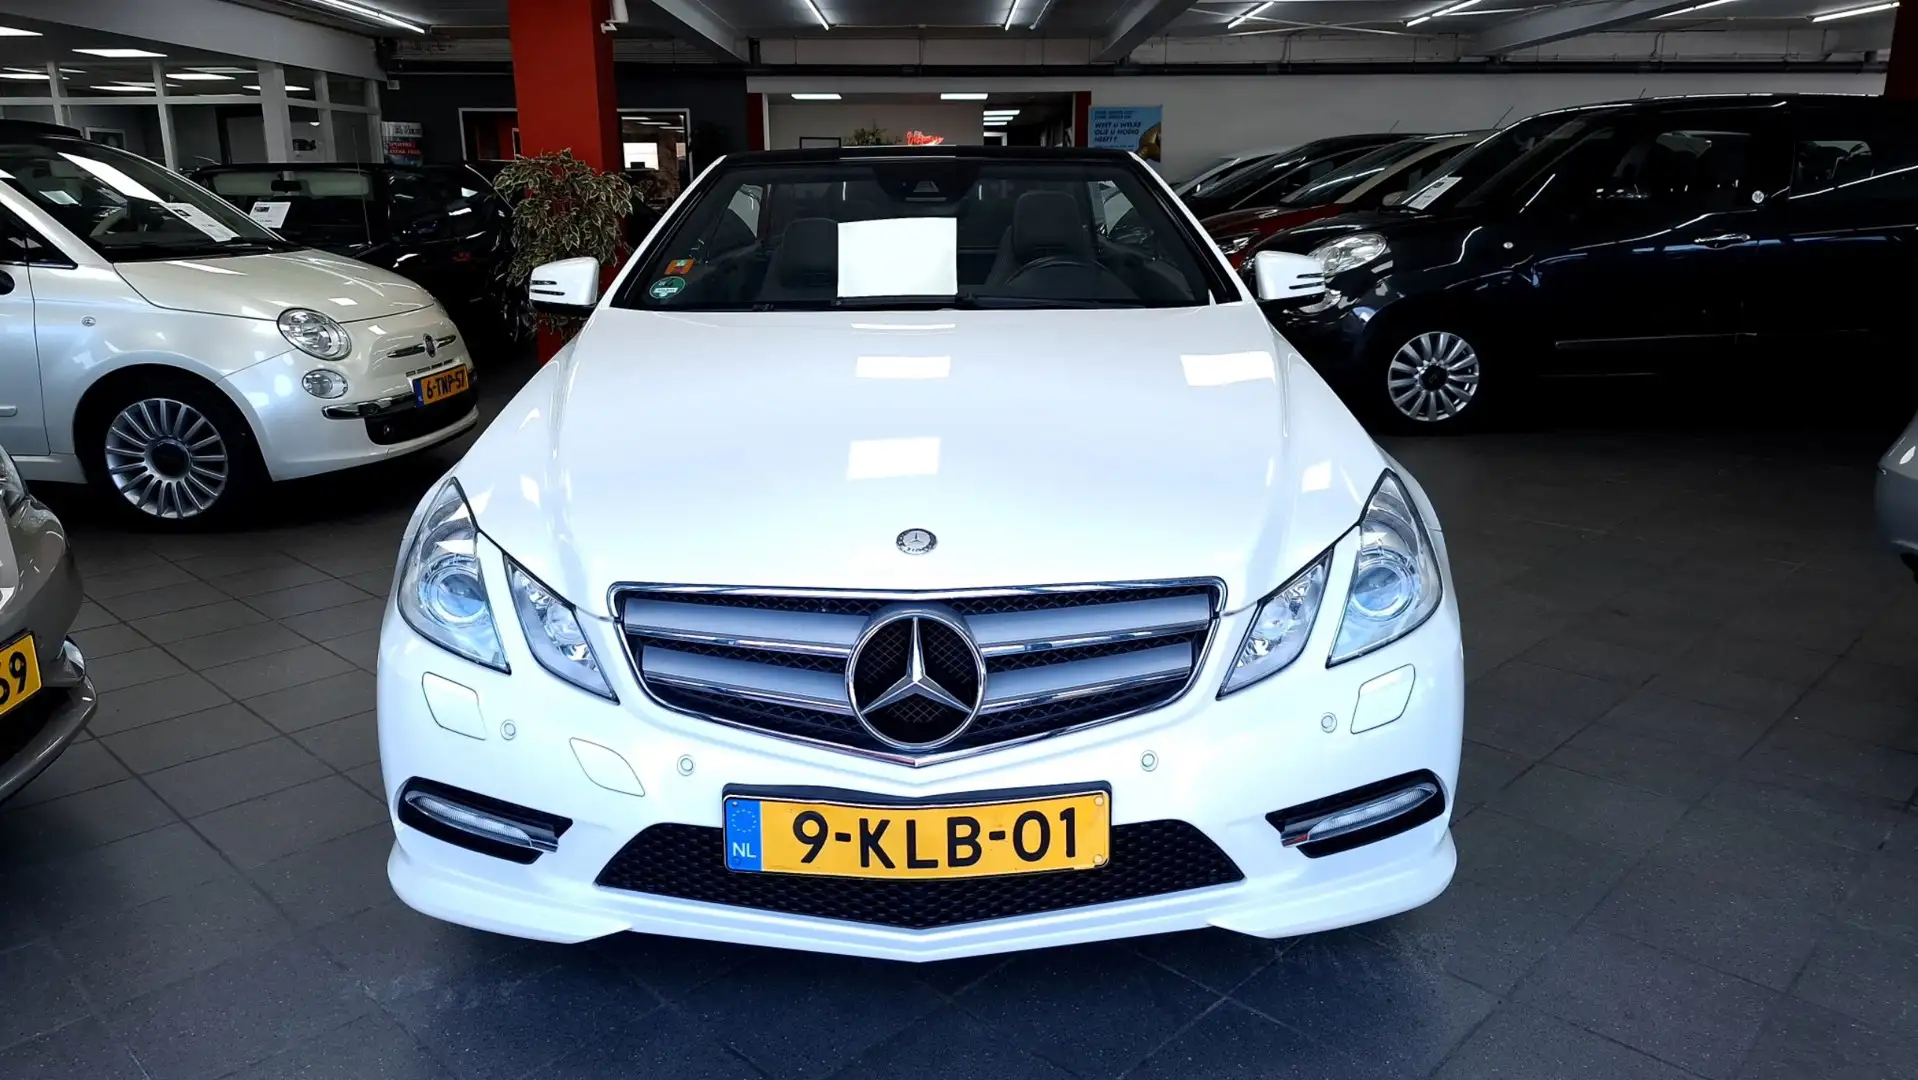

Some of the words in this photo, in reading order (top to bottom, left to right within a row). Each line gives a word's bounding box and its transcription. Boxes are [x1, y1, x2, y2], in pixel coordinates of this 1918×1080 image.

[426, 371, 465, 399] 6-TNP-57
[732, 841, 757, 858] NL
[792, 807, 1076, 870] 9-KLB-01
